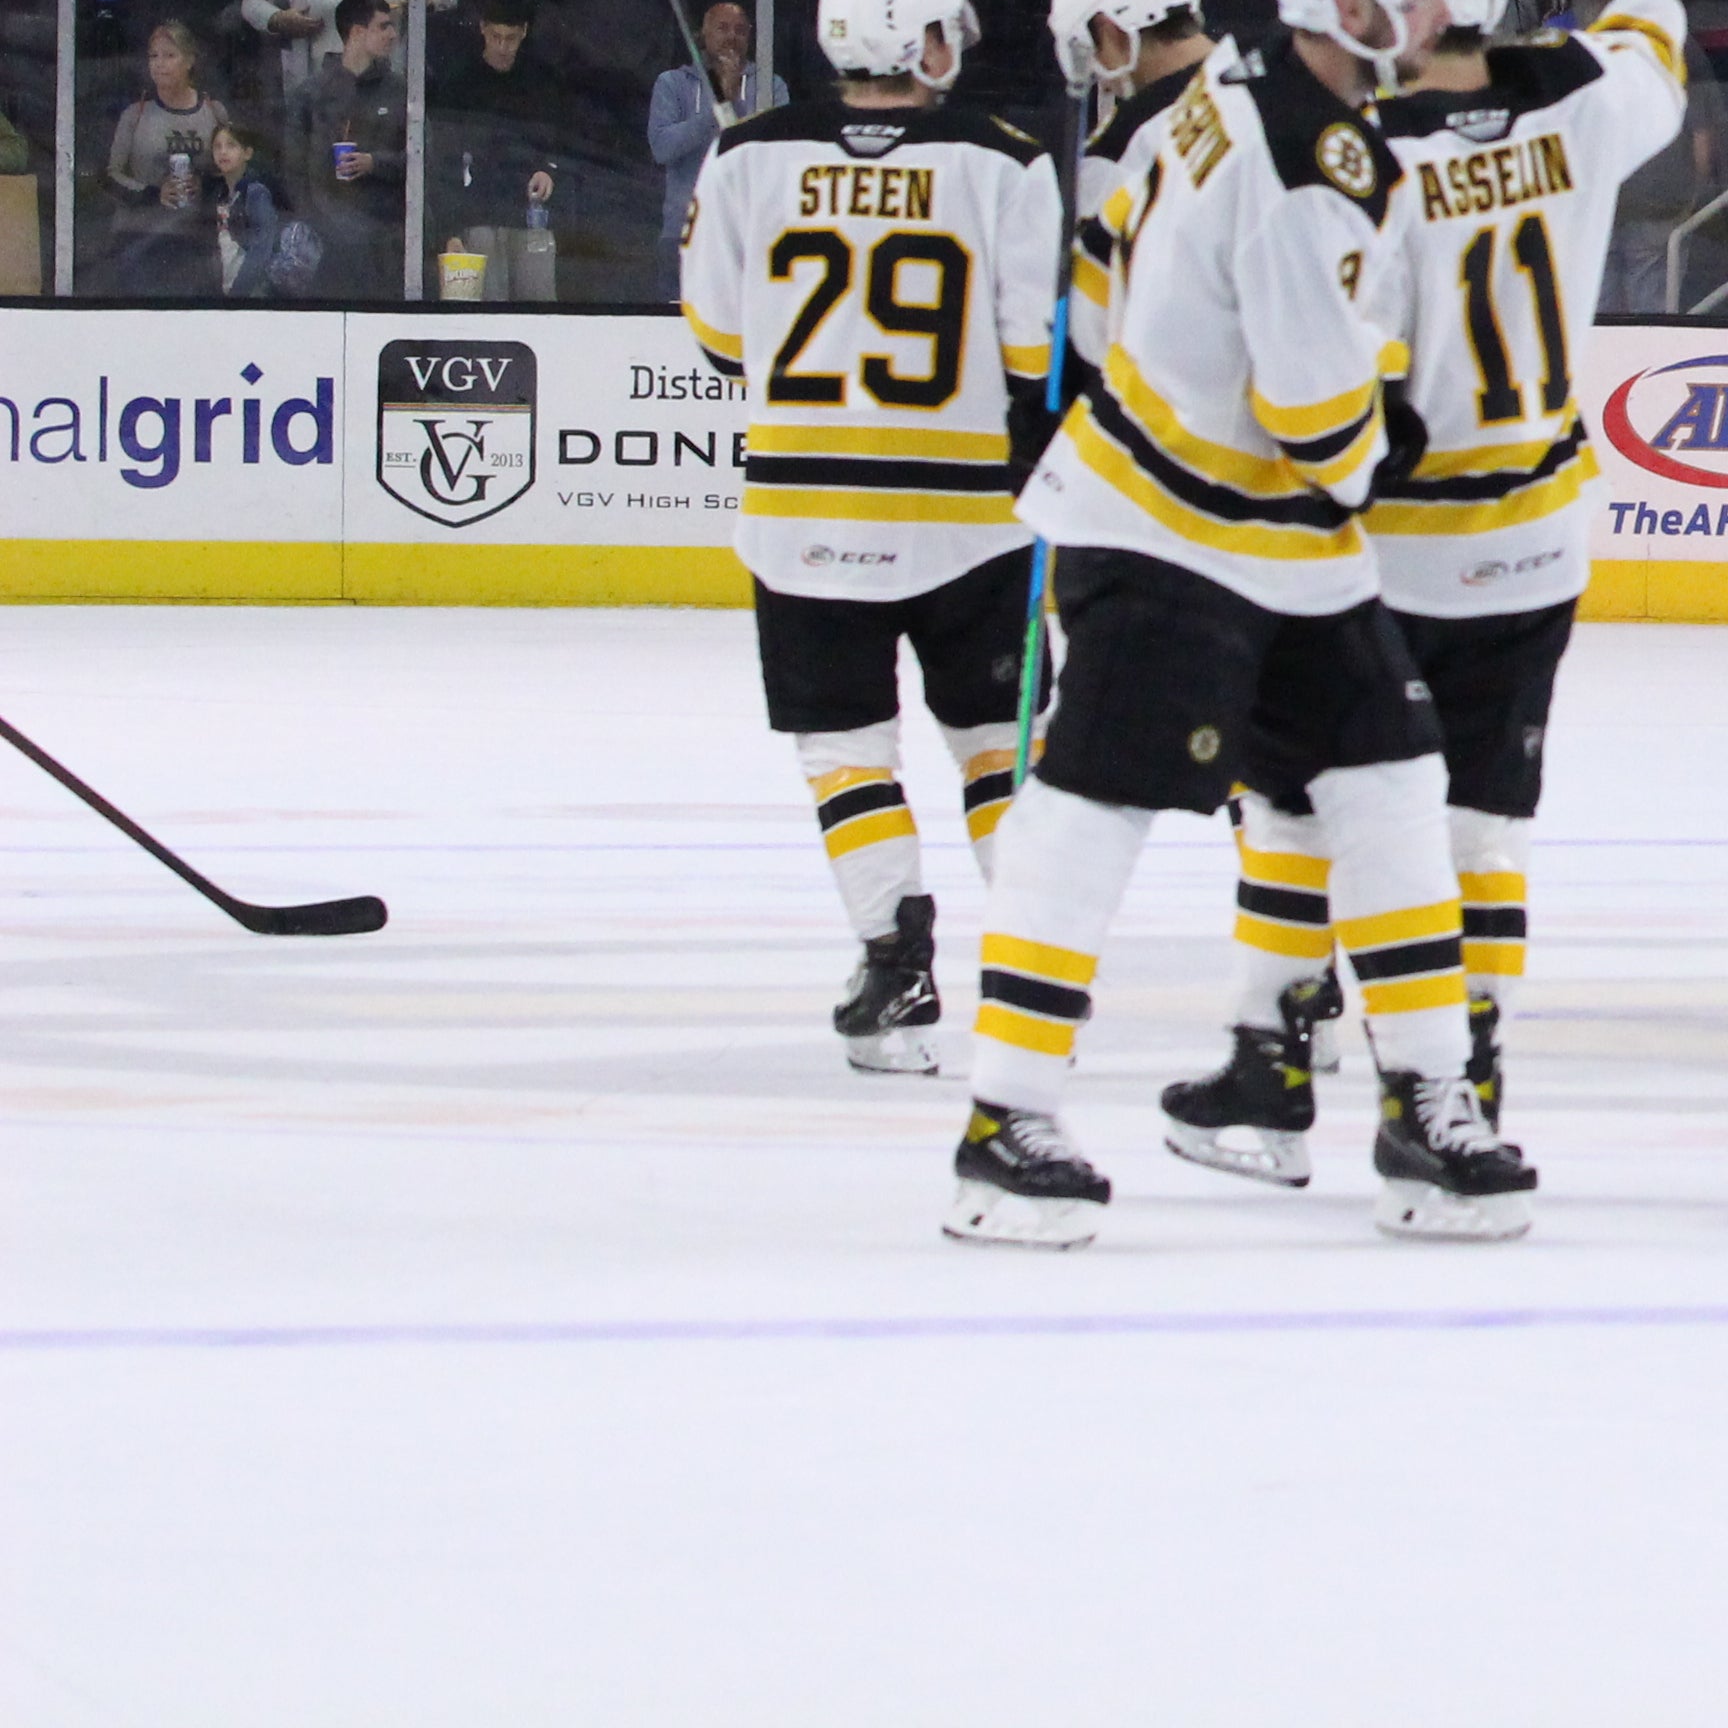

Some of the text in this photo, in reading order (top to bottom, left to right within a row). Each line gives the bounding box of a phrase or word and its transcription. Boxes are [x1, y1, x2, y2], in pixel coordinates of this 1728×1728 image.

[799, 163, 935, 221] STEEN
[764, 224, 976, 413] 29
[1458, 209, 1575, 430] 11
[403, 355, 513, 392] VGV
[385, 450, 525, 469] EST. 2013
[557, 491, 615, 508] VGV
